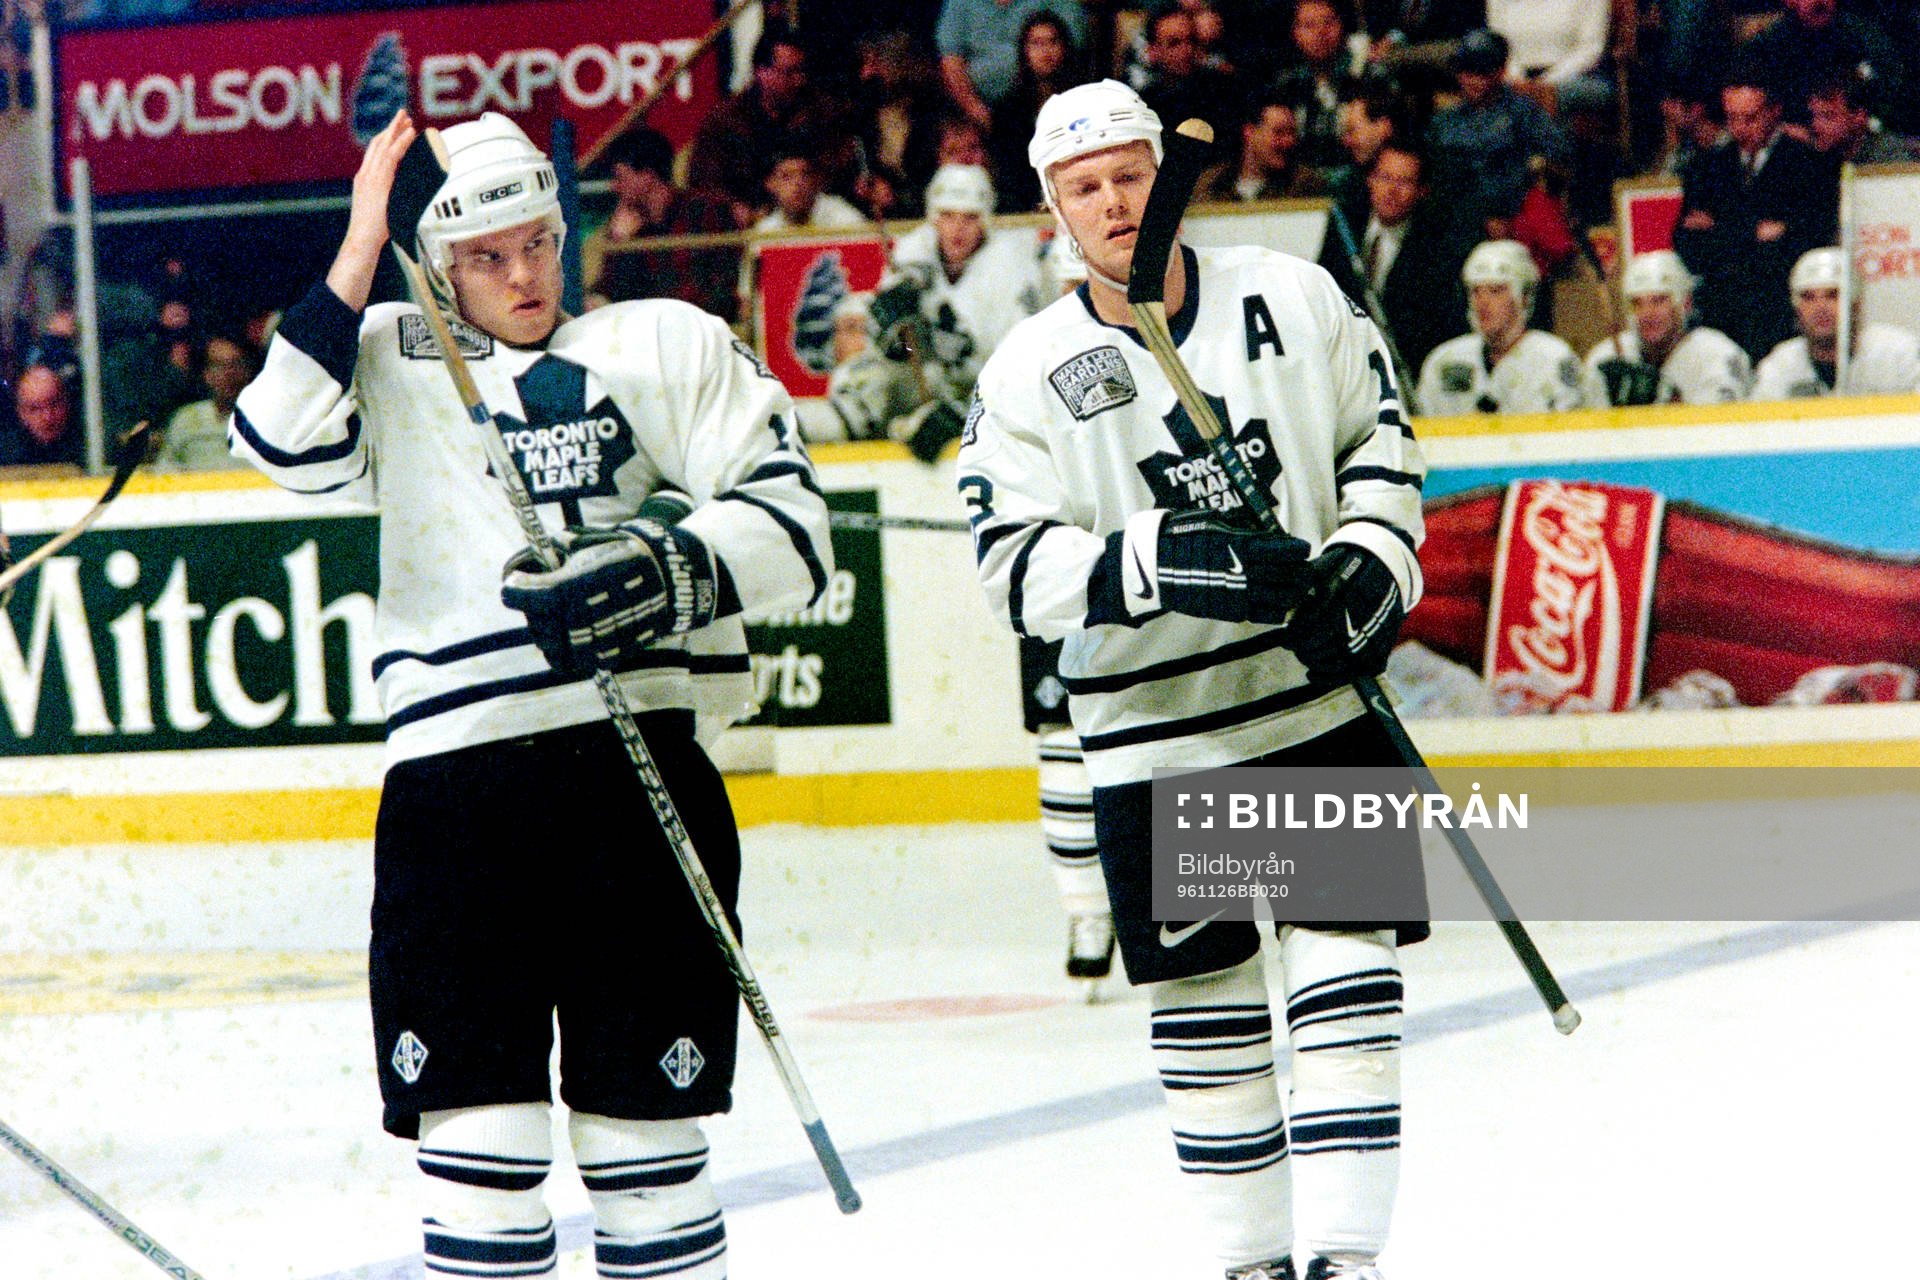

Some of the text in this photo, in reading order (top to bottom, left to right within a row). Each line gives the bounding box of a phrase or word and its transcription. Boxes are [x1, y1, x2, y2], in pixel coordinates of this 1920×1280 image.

[73, 38, 701, 141] MOLSON EXPORT
[481, 184, 522, 203] CCM
[1243, 294, 1286, 361] A
[1060, 357, 1122, 391] GARDENS
[502, 416, 619, 453] TORONTO
[524, 441, 602, 473] MAPLE
[1163, 437, 1267, 488] TOROTO
[530, 463, 600, 492] LEAFS
[751, 644, 825, 708] rts
